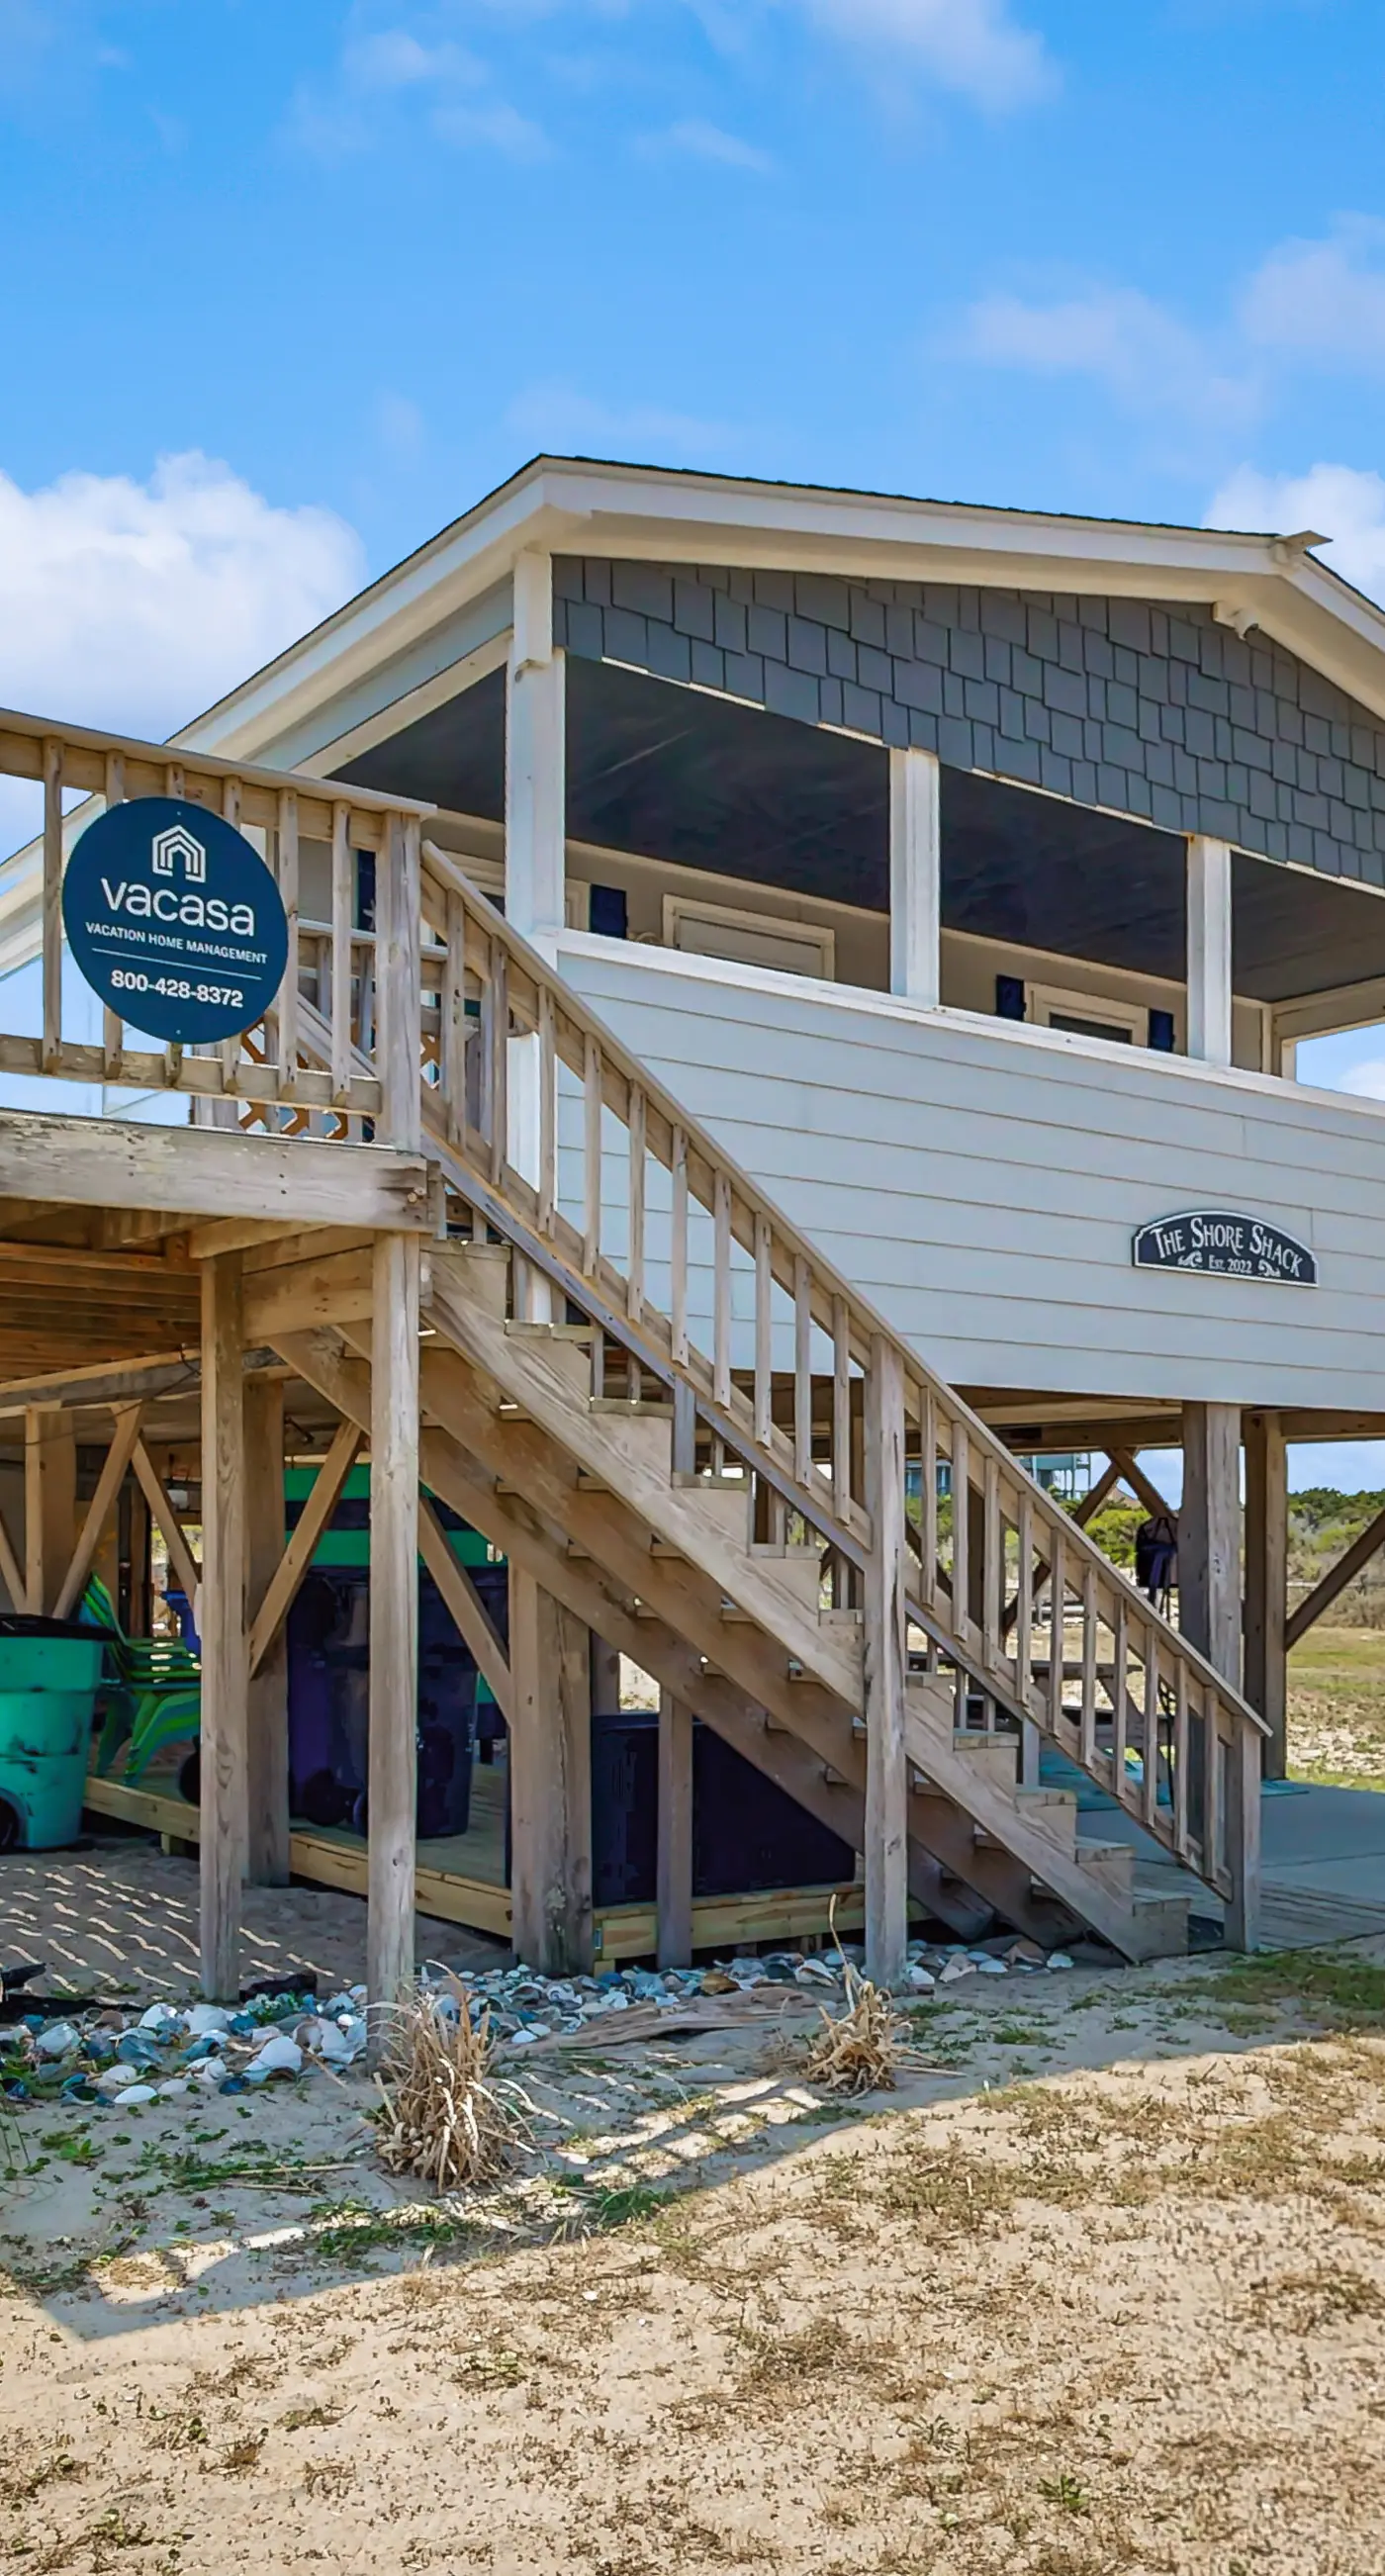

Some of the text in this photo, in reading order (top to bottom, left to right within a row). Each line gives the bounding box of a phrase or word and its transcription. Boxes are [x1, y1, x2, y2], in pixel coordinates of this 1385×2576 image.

[101, 876, 254, 937] vacasa
[85, 921, 268, 965] VACATION HOME MANAGEMENT
[110, 968, 244, 1008] 800-428-8372
[1150, 1217, 1303, 1278] THE SHORE SHACK
[1227, 1257, 1252, 1274] 2022
